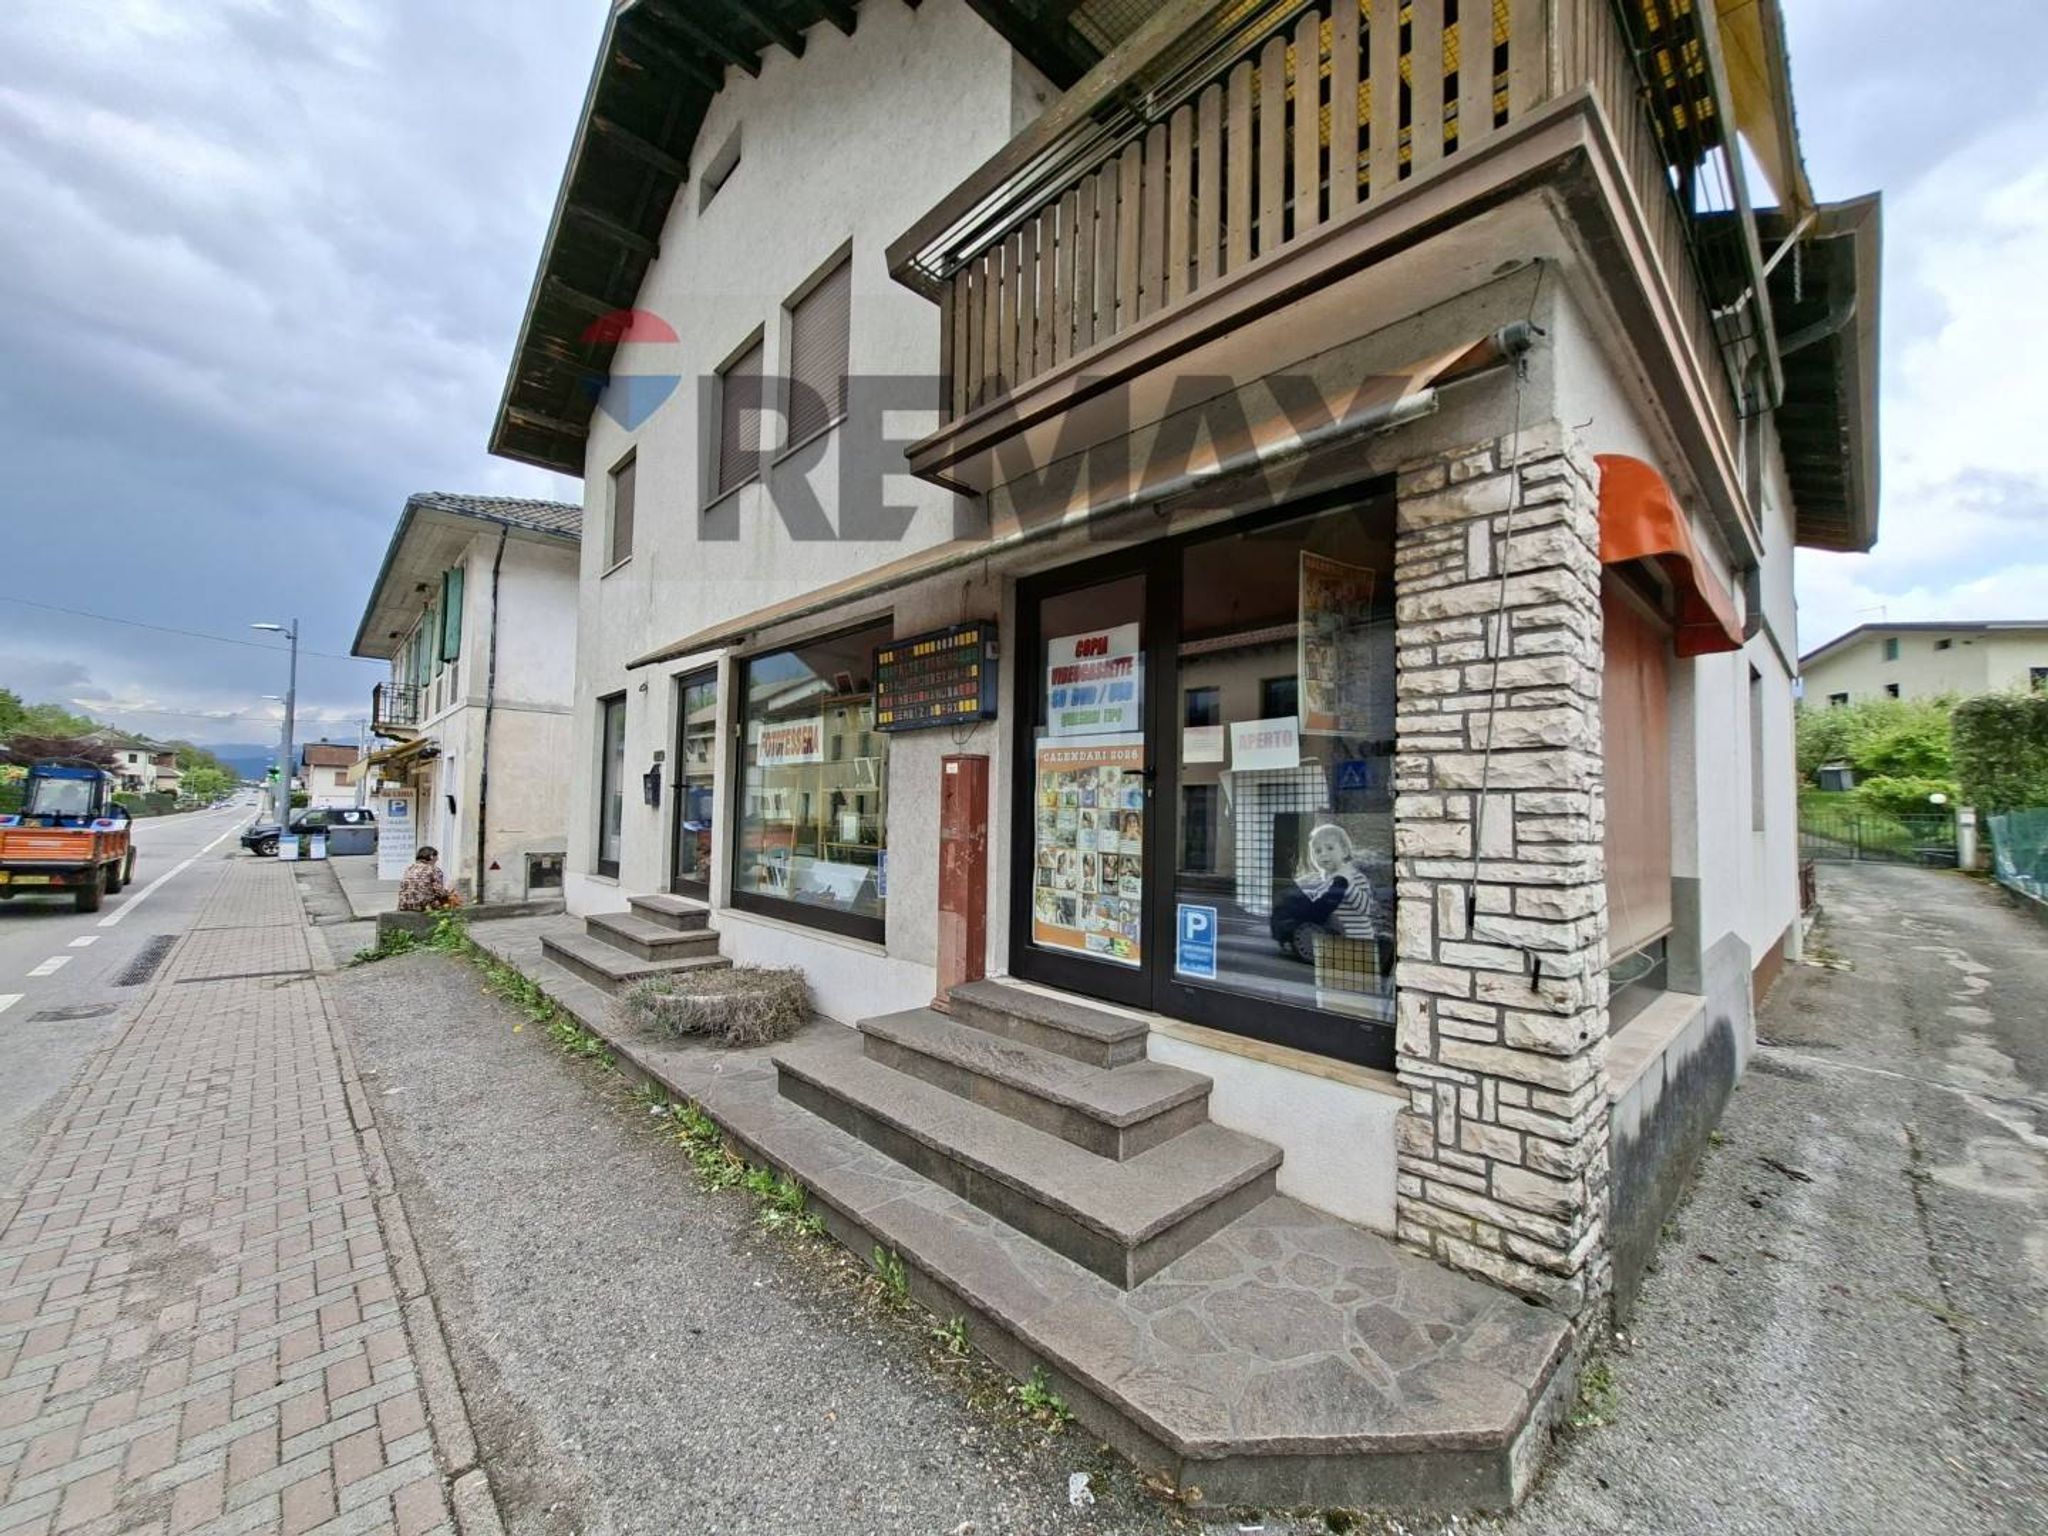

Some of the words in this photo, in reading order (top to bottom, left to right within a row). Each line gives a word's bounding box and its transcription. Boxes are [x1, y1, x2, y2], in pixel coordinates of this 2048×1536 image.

[1239, 729, 1293, 750] APERTO
[1043, 751, 1108, 763] CALENDARI
[1186, 912, 1208, 939] P
